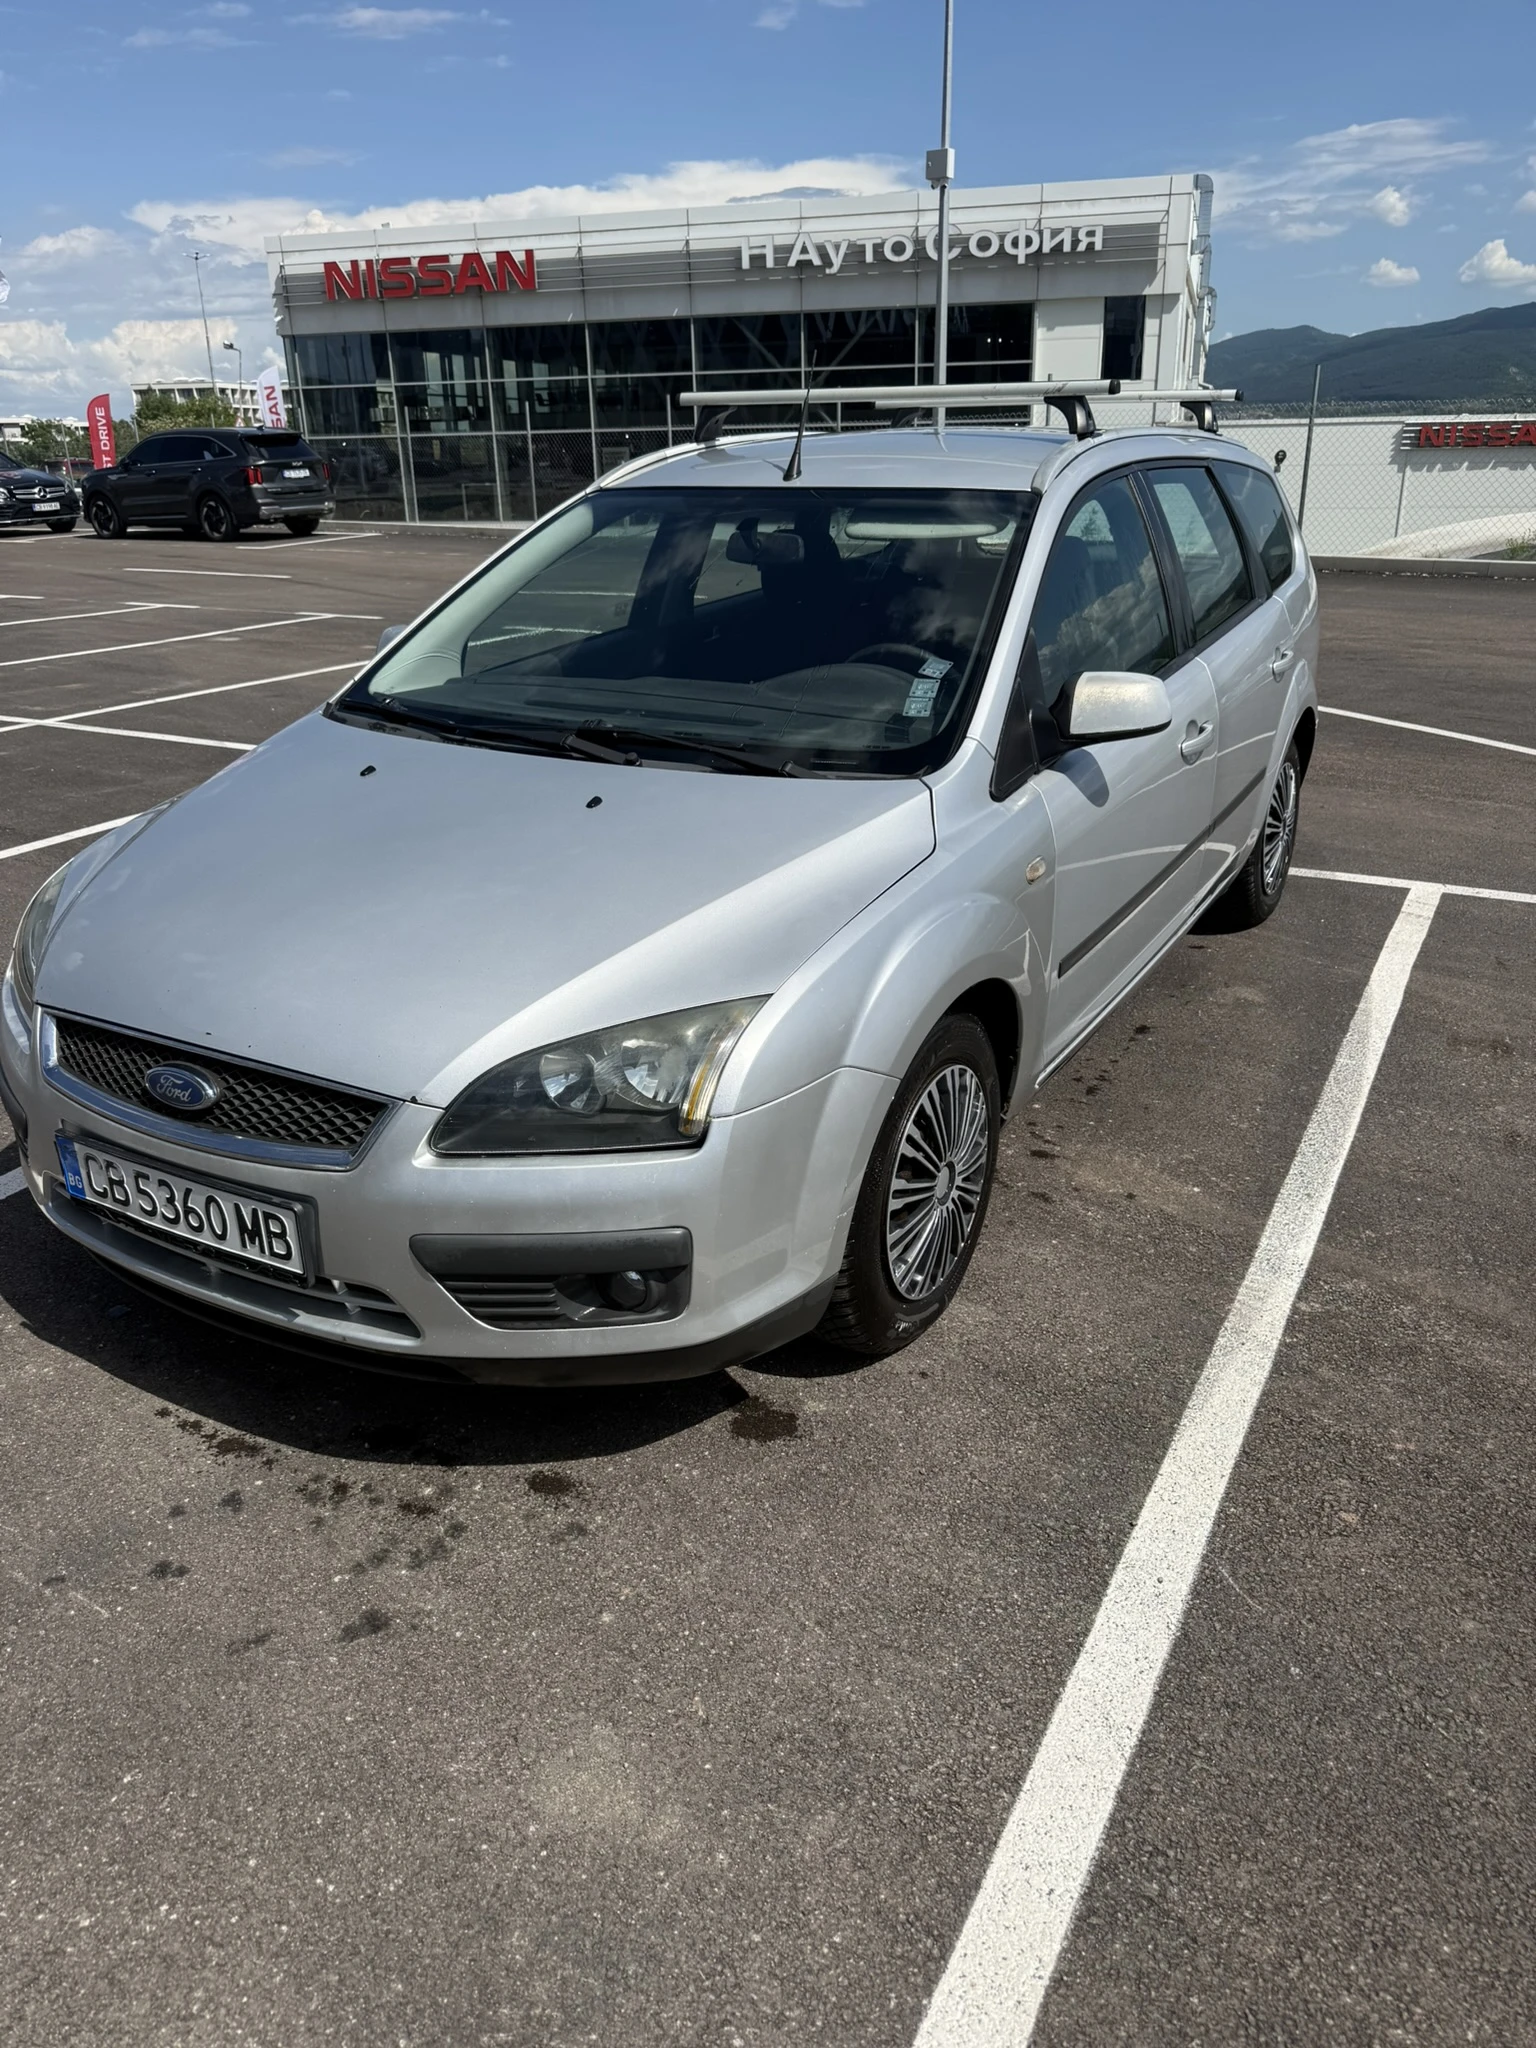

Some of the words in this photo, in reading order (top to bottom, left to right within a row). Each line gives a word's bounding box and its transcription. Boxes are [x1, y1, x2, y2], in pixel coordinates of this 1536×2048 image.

[926, 219, 1104, 265] София
[323, 249, 538, 301] NISSAN
[95, 407, 110, 450] DRIVE
[156, 1074, 193, 1103] Ford
[67, 1172, 83, 1189] BG
[84, 1153, 131, 1207] CB
[133, 1169, 229, 1242] 5360
[234, 1202, 293, 1262] MB
